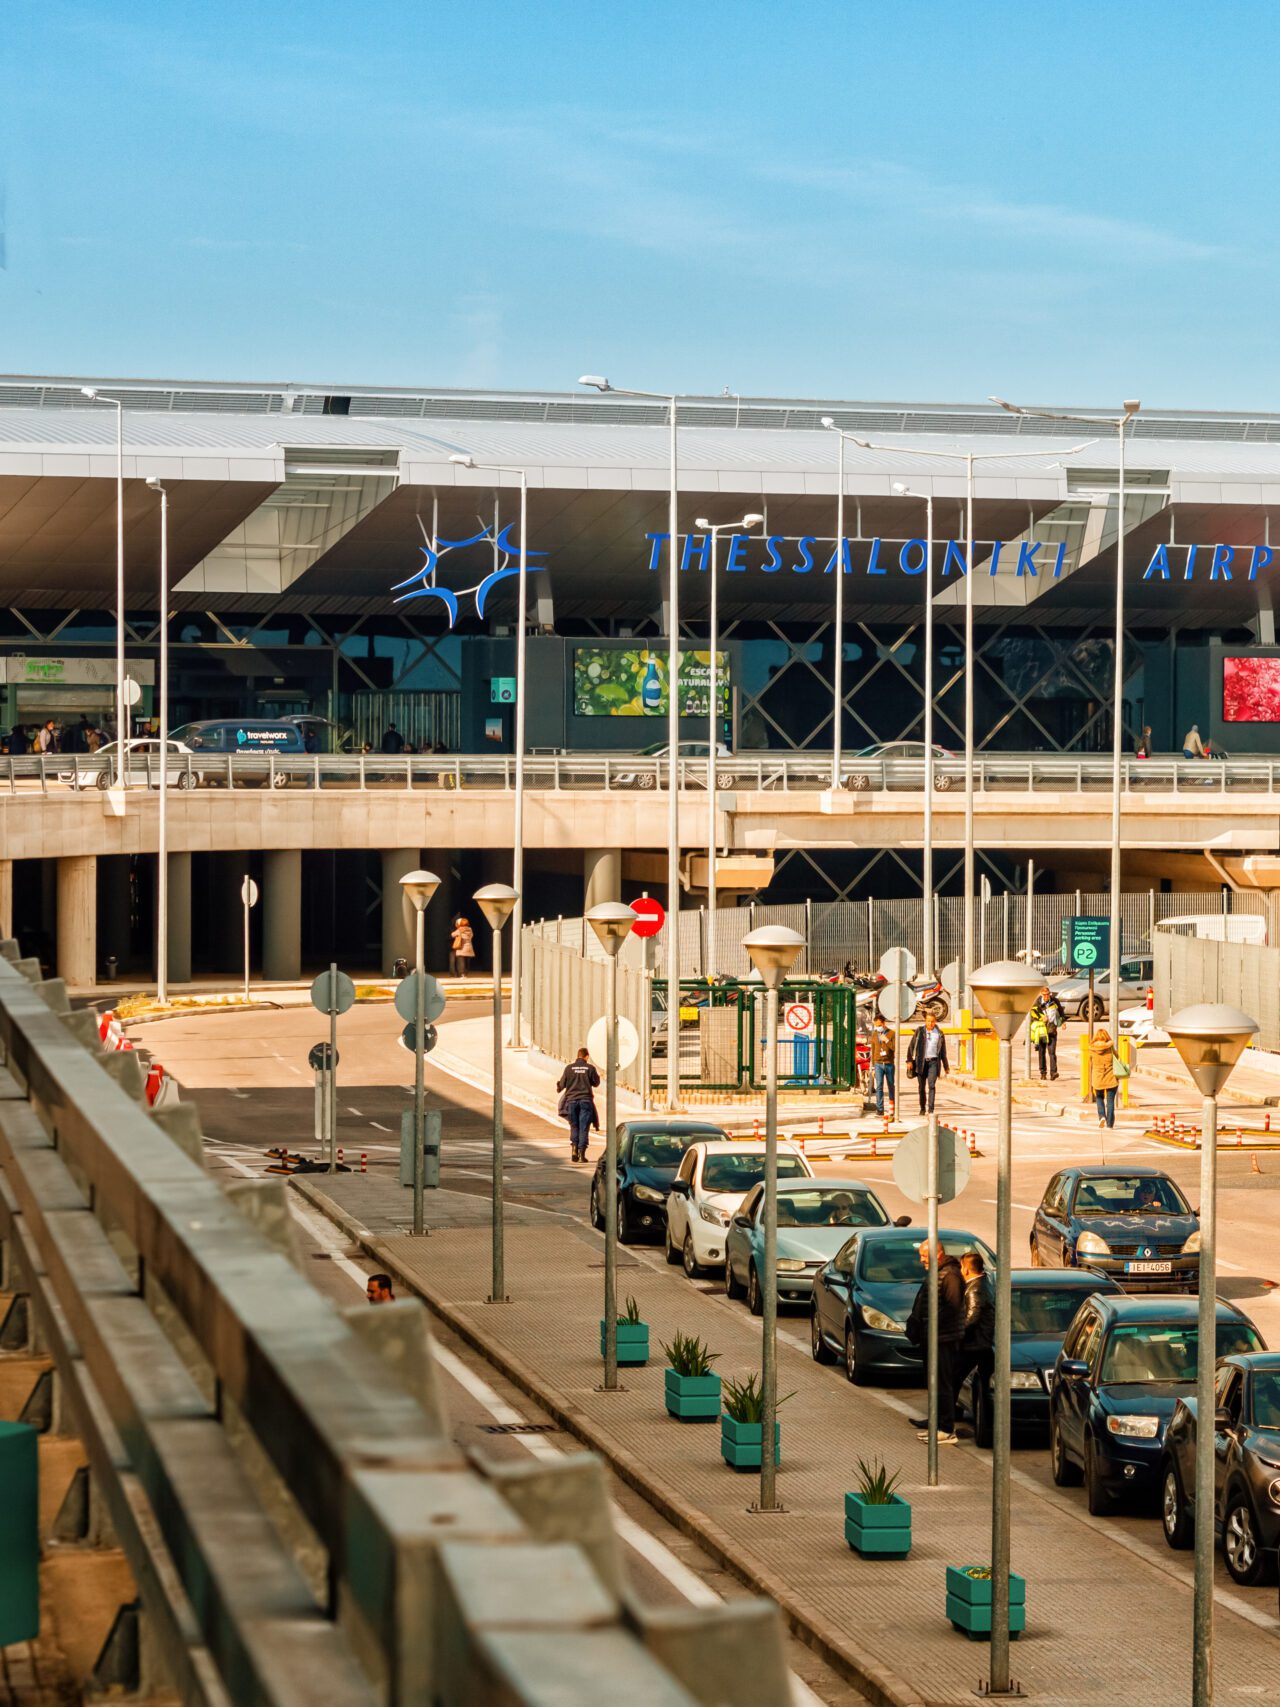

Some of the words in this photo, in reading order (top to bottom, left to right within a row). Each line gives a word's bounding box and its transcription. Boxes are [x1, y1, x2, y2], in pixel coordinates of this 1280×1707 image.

[645, 533, 1066, 577] THESSALONIKI
[247, 731, 287, 739] travelworx
[1077, 948, 1094, 960] P2
